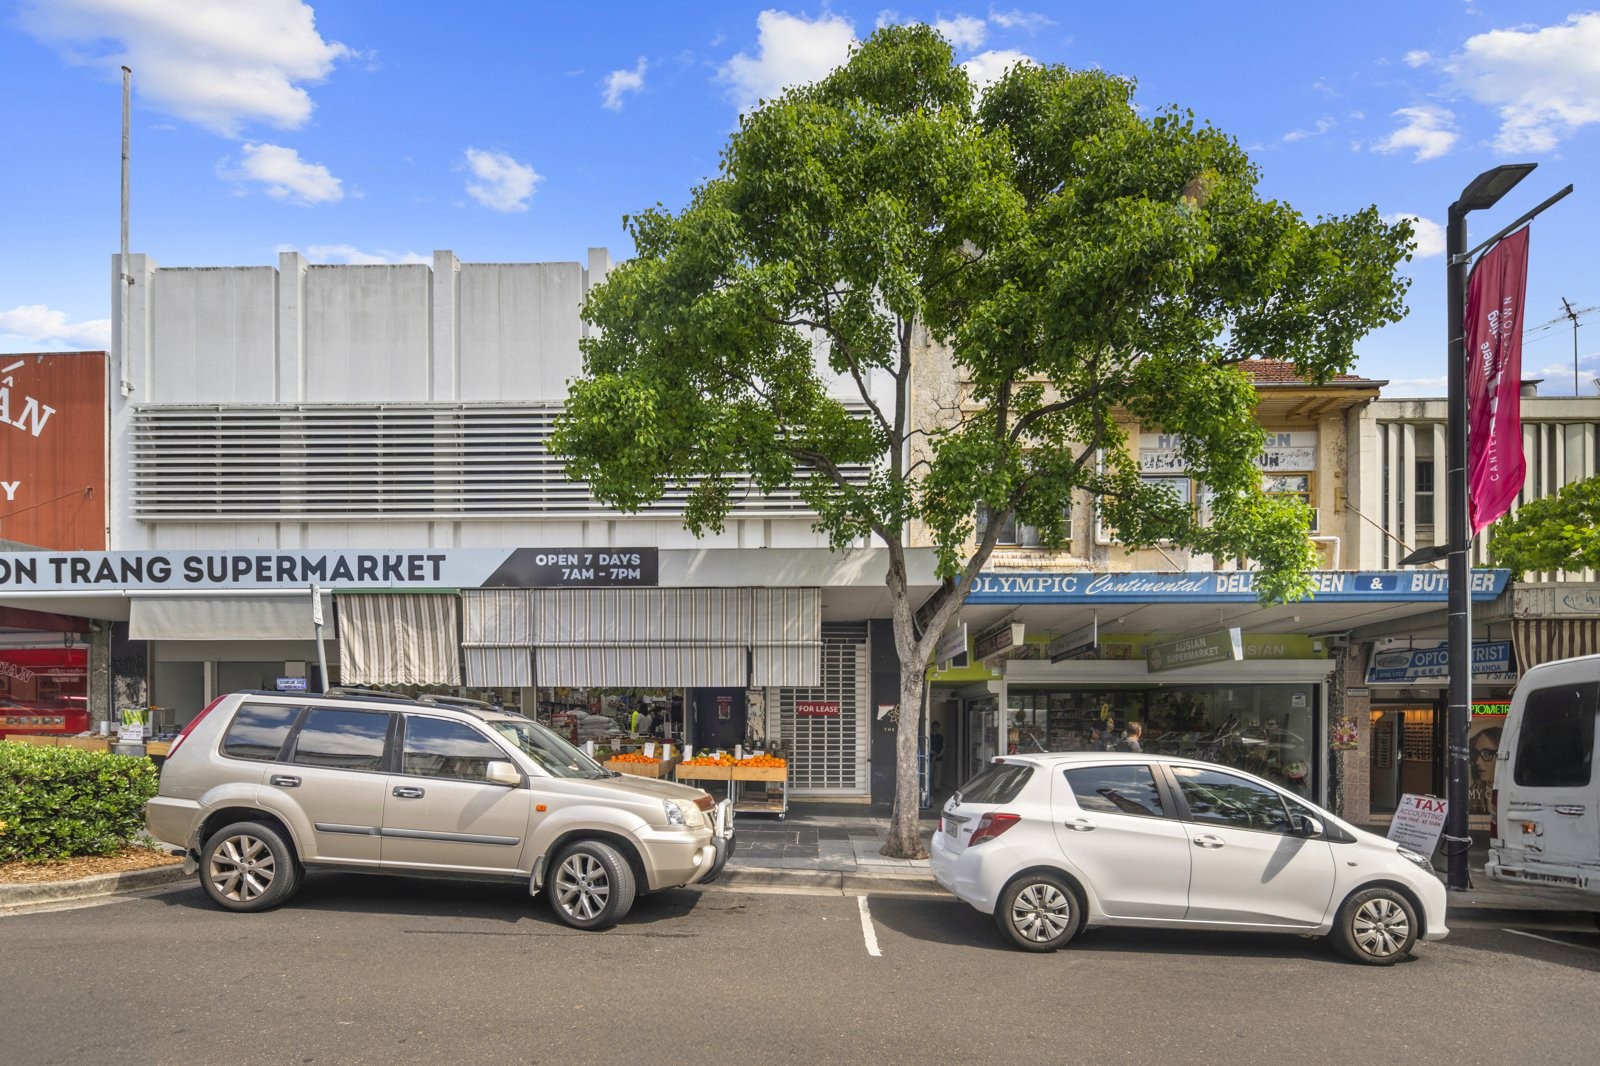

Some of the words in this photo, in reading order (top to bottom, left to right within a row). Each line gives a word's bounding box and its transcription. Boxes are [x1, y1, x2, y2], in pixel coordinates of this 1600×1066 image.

[535, 554, 578, 566] OPEN
[584, 554, 592, 565] 7
[599, 554, 640, 565] DAYS
[49, 557, 171, 583] TRANG
[183, 555, 446, 583] SUPERMARKET
[562, 568, 593, 580] 7AM
[610, 568, 640, 580] 7PM
[1085, 574, 1208, 595] Continental
[1370, 577, 1383, 590] &
[1411, 573, 1495, 592] BUTER
[1175, 638, 1206, 653] AUSIAN
[1166, 646, 1219, 664] SUPERMARKET
[1415, 646, 1505, 666] OPTOTRIST
[1414, 798, 1447, 813] TAX
[1398, 808, 1443, 821] ACCOUNTING
